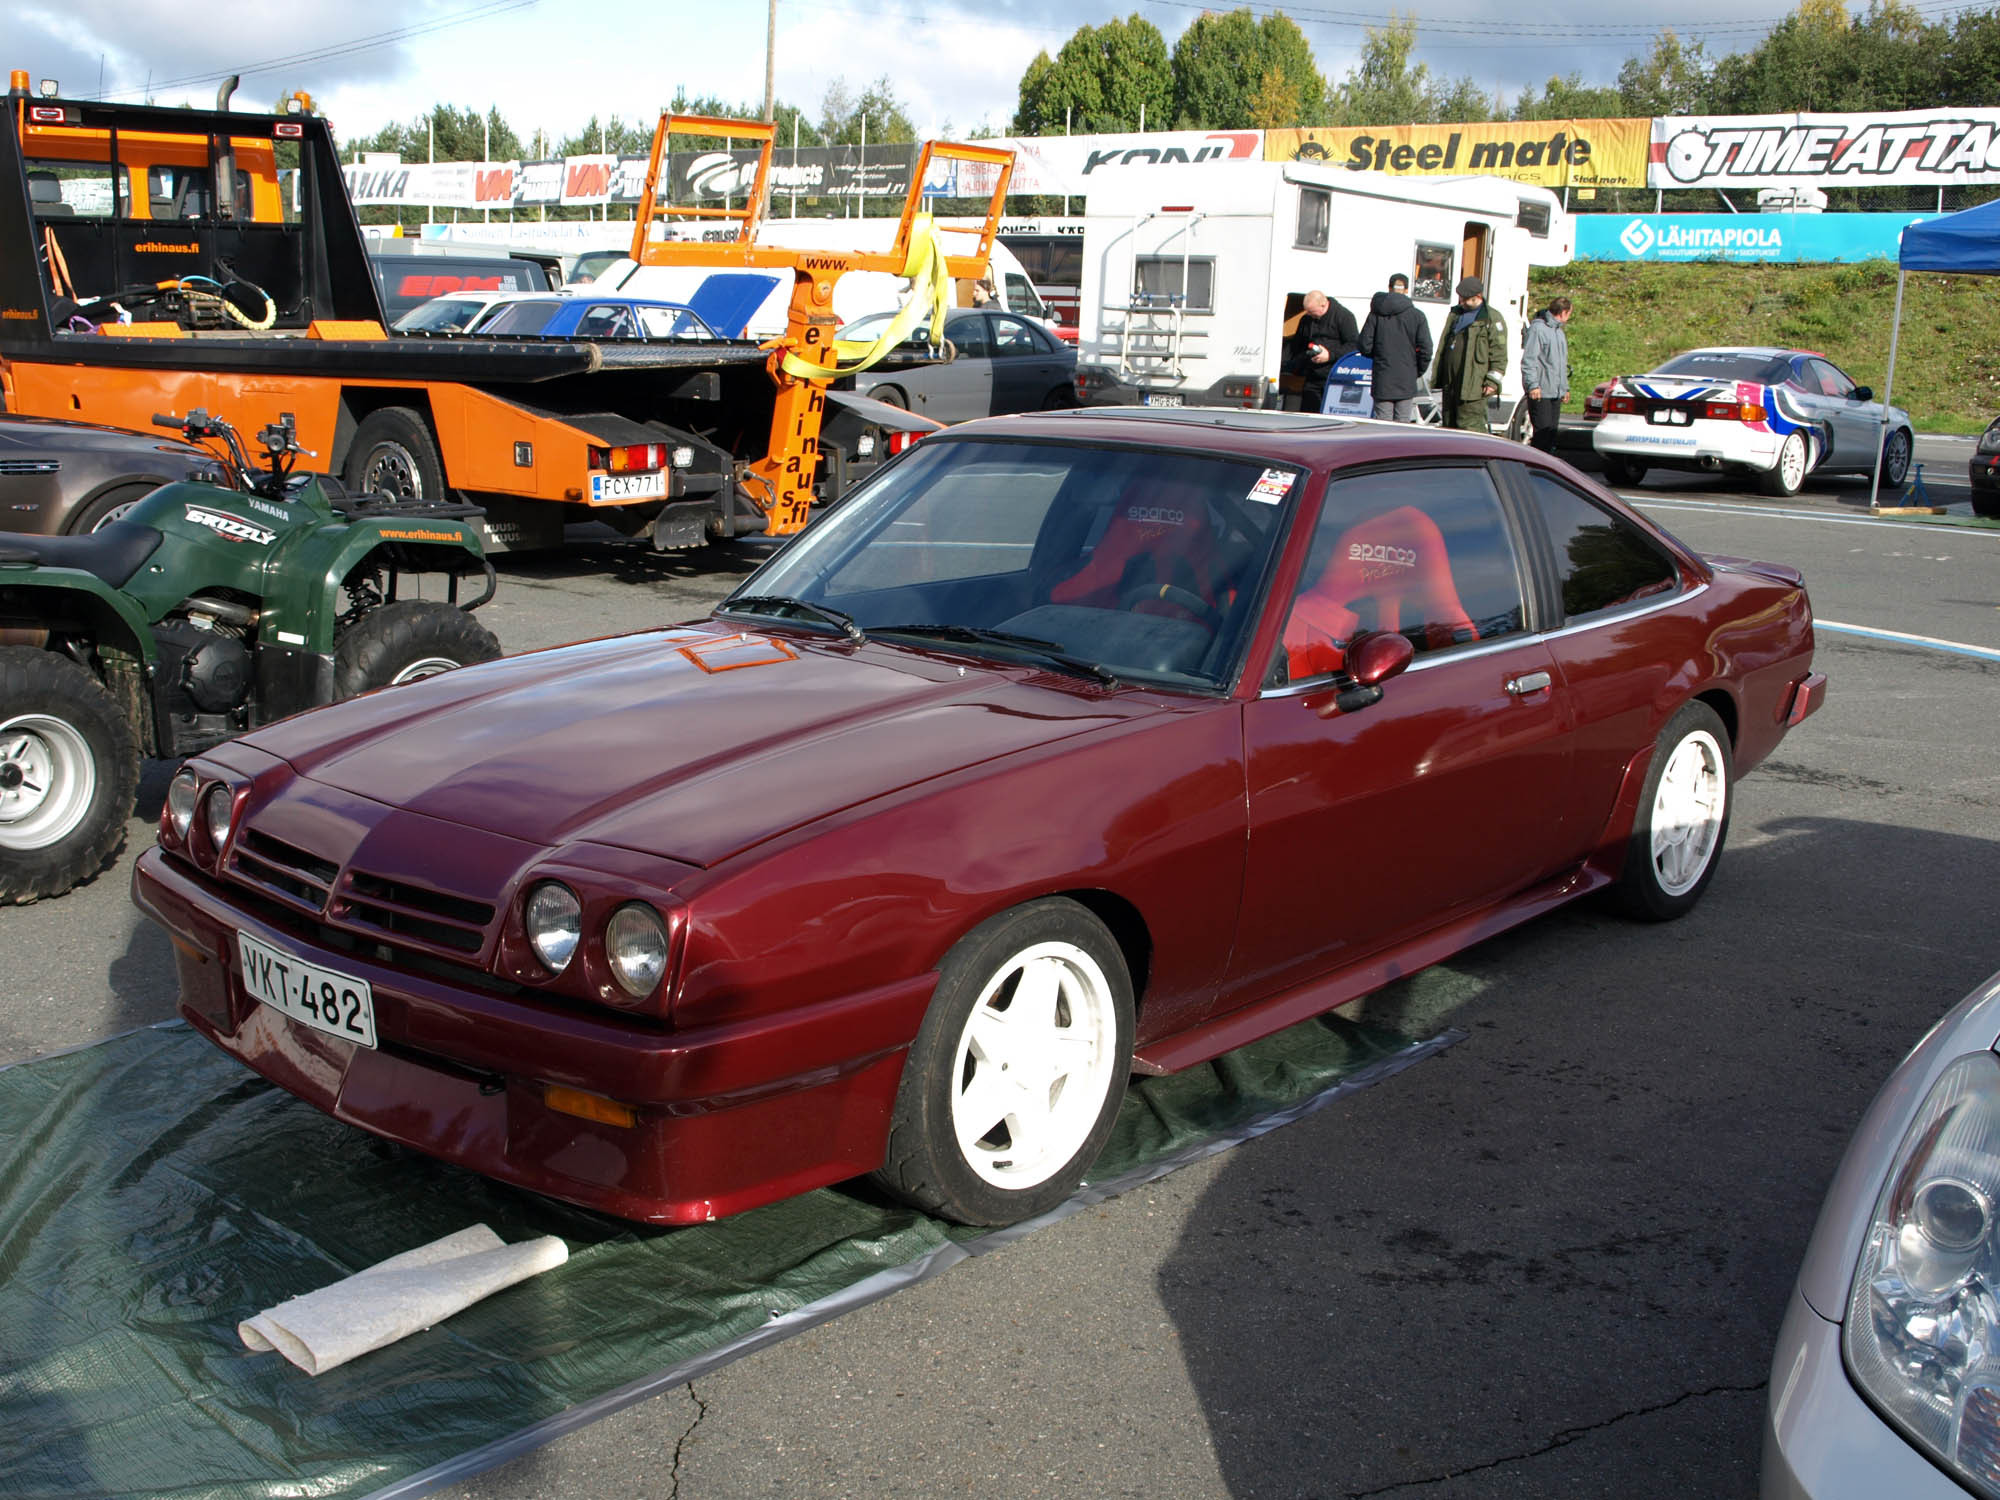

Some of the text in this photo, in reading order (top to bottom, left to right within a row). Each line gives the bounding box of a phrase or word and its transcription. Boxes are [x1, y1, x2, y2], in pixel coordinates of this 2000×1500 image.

[1346, 132, 1592, 171] Steel mate
[1701, 126, 1848, 176] TIME
[1572, 174, 1598, 184] Steel
[1658, 225, 1782, 246] LÄHITAPIOLA
[134, 242, 200, 254] erihinaus.fi
[805, 257, 850, 271] www.
[604, 476, 659, 496] FCX-771
[248, 498, 290, 521] YAMAHA
[1128, 505, 1184, 524] sparco
[185, 510, 277, 545] GRIZZLY
[379, 527, 463, 543] www.erihinaus.fi
[1349, 543, 1417, 564] sparco
[244, 944, 364, 1036] VKT-482
